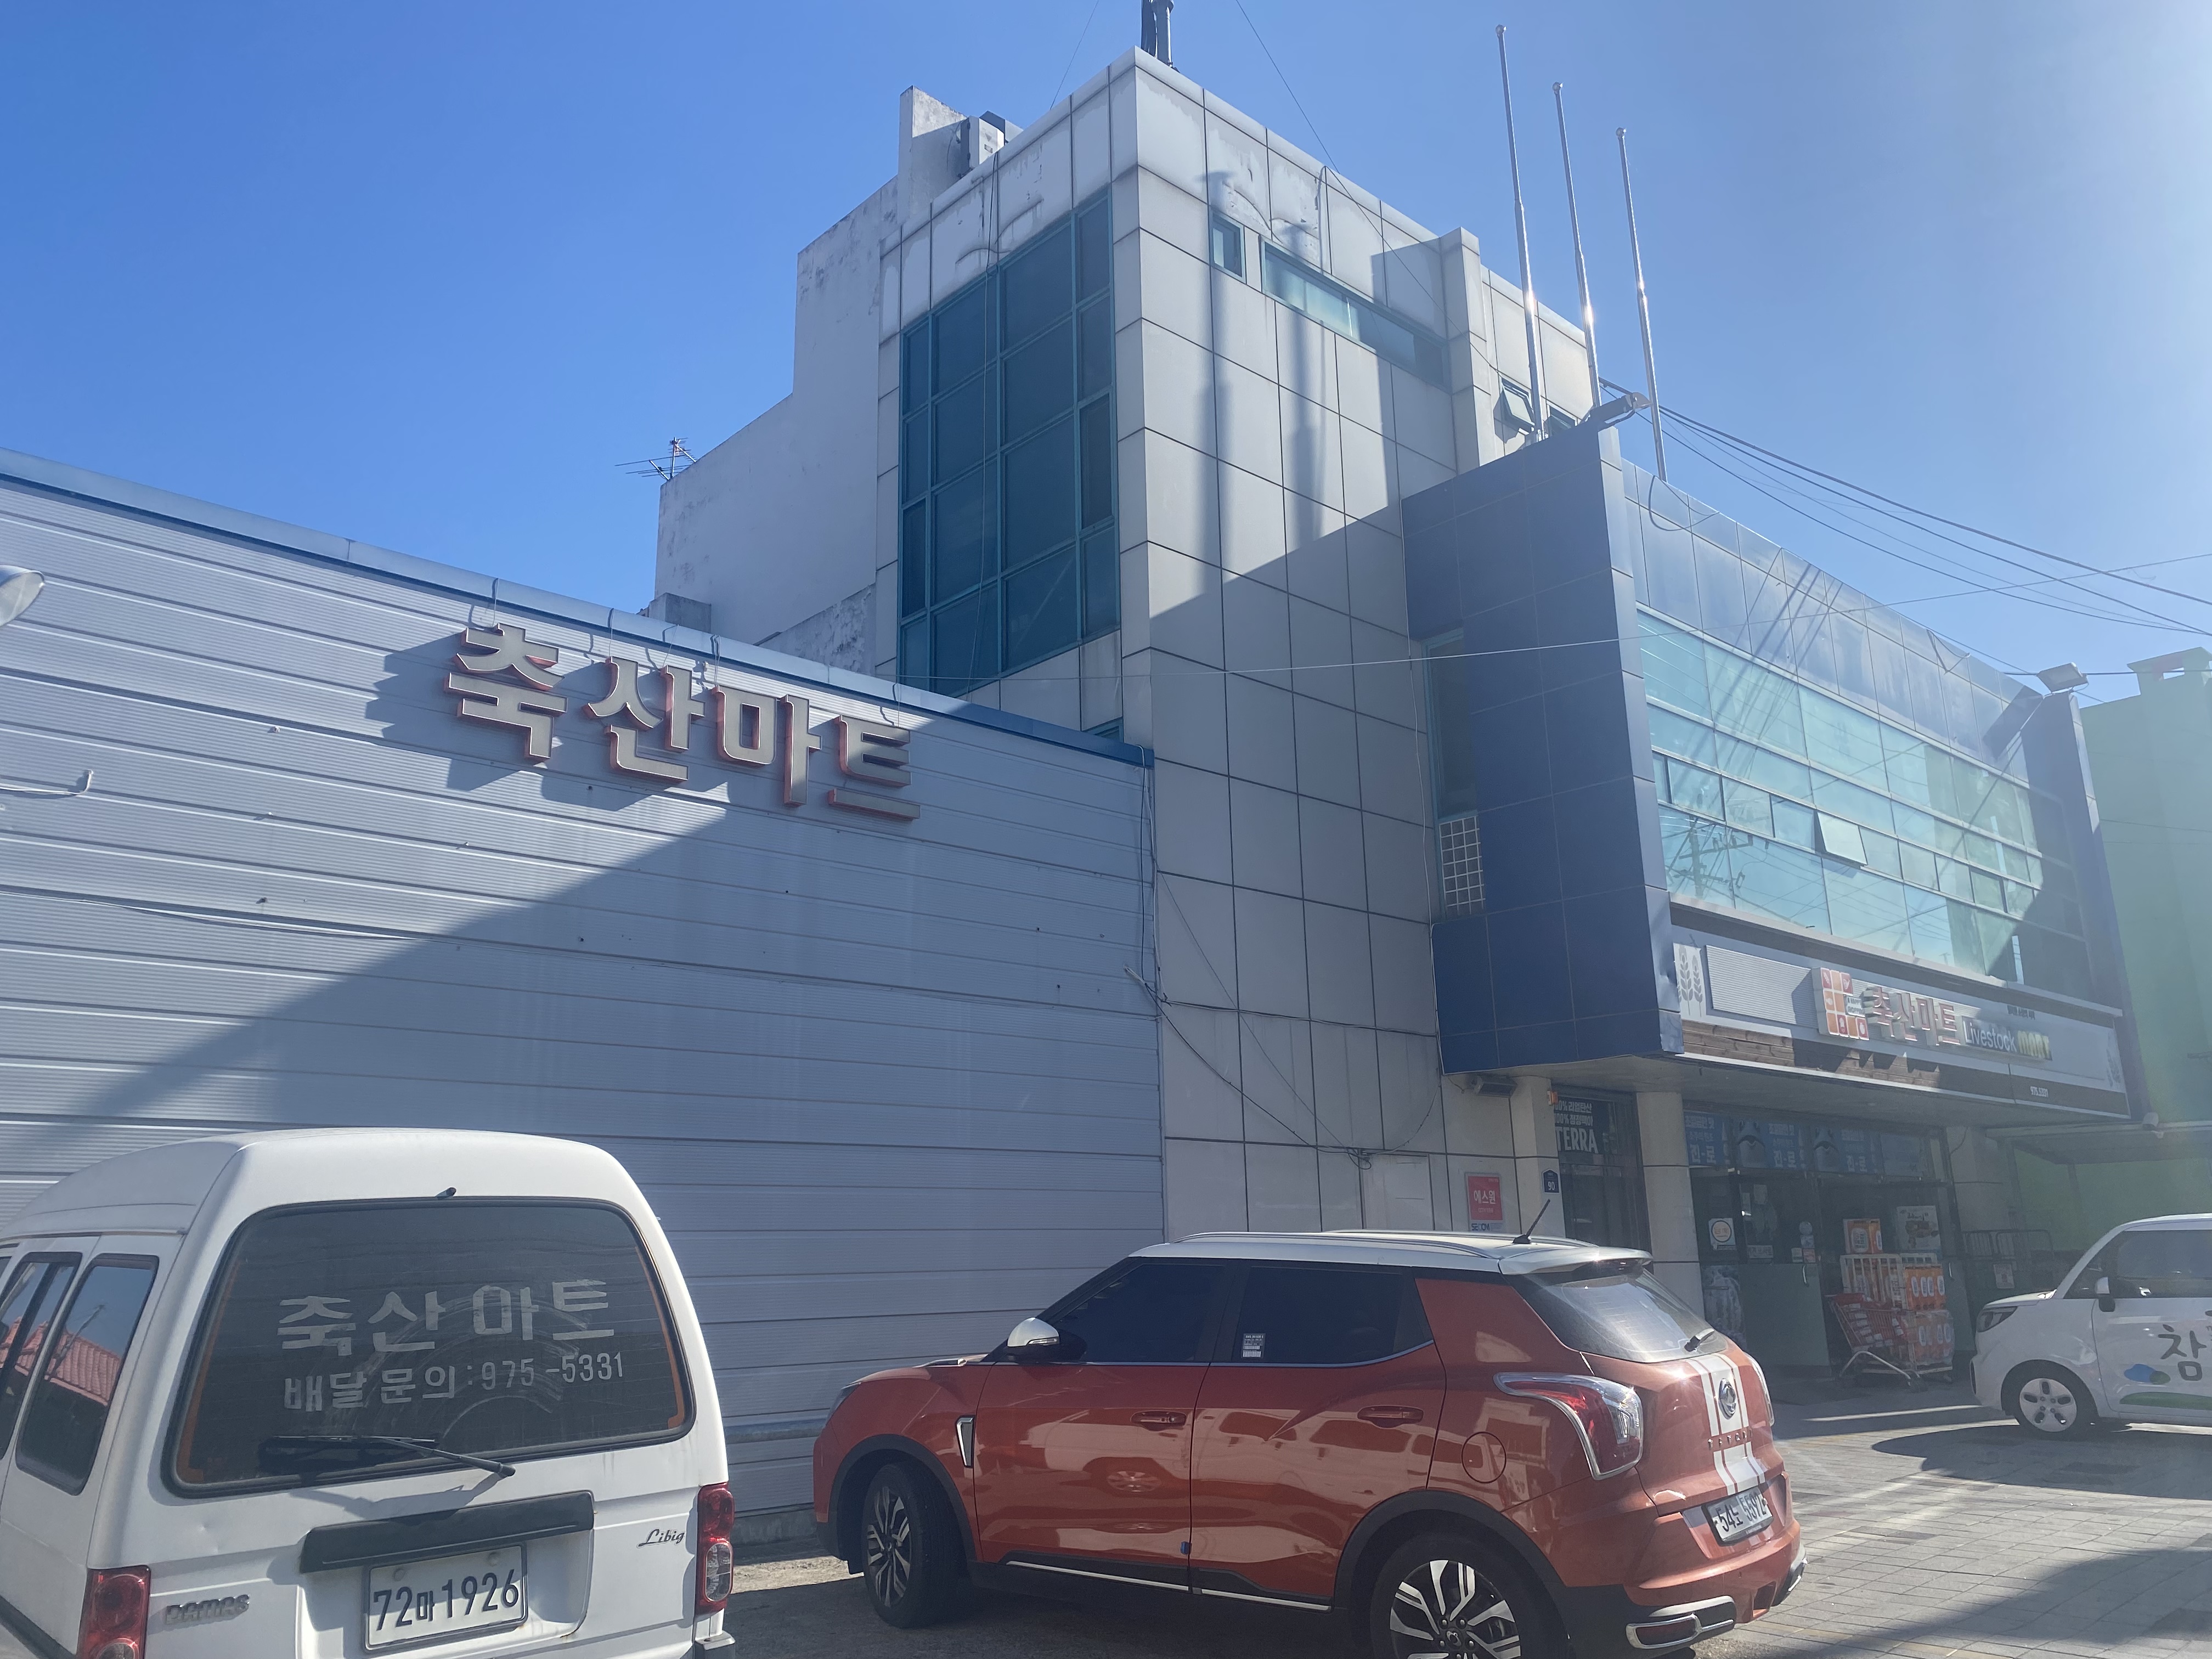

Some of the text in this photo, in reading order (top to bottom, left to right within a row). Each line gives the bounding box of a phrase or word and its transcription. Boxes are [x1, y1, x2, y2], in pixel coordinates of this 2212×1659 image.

[443, 623, 921, 820] 축산마트
[1863, 986, 1961, 1046] 축산마트
[1963, 1020, 2051, 1059] Livestock MART
[1555, 1126, 1599, 1154] TERRA
[1474, 1190, 1496, 1204] 에스원
[1548, 1181, 1555, 1190] 90
[2158, 1324, 2207, 1381] 참
[637, 1528, 685, 1547] Libig
[373, 1569, 519, 1631] 72마1926
